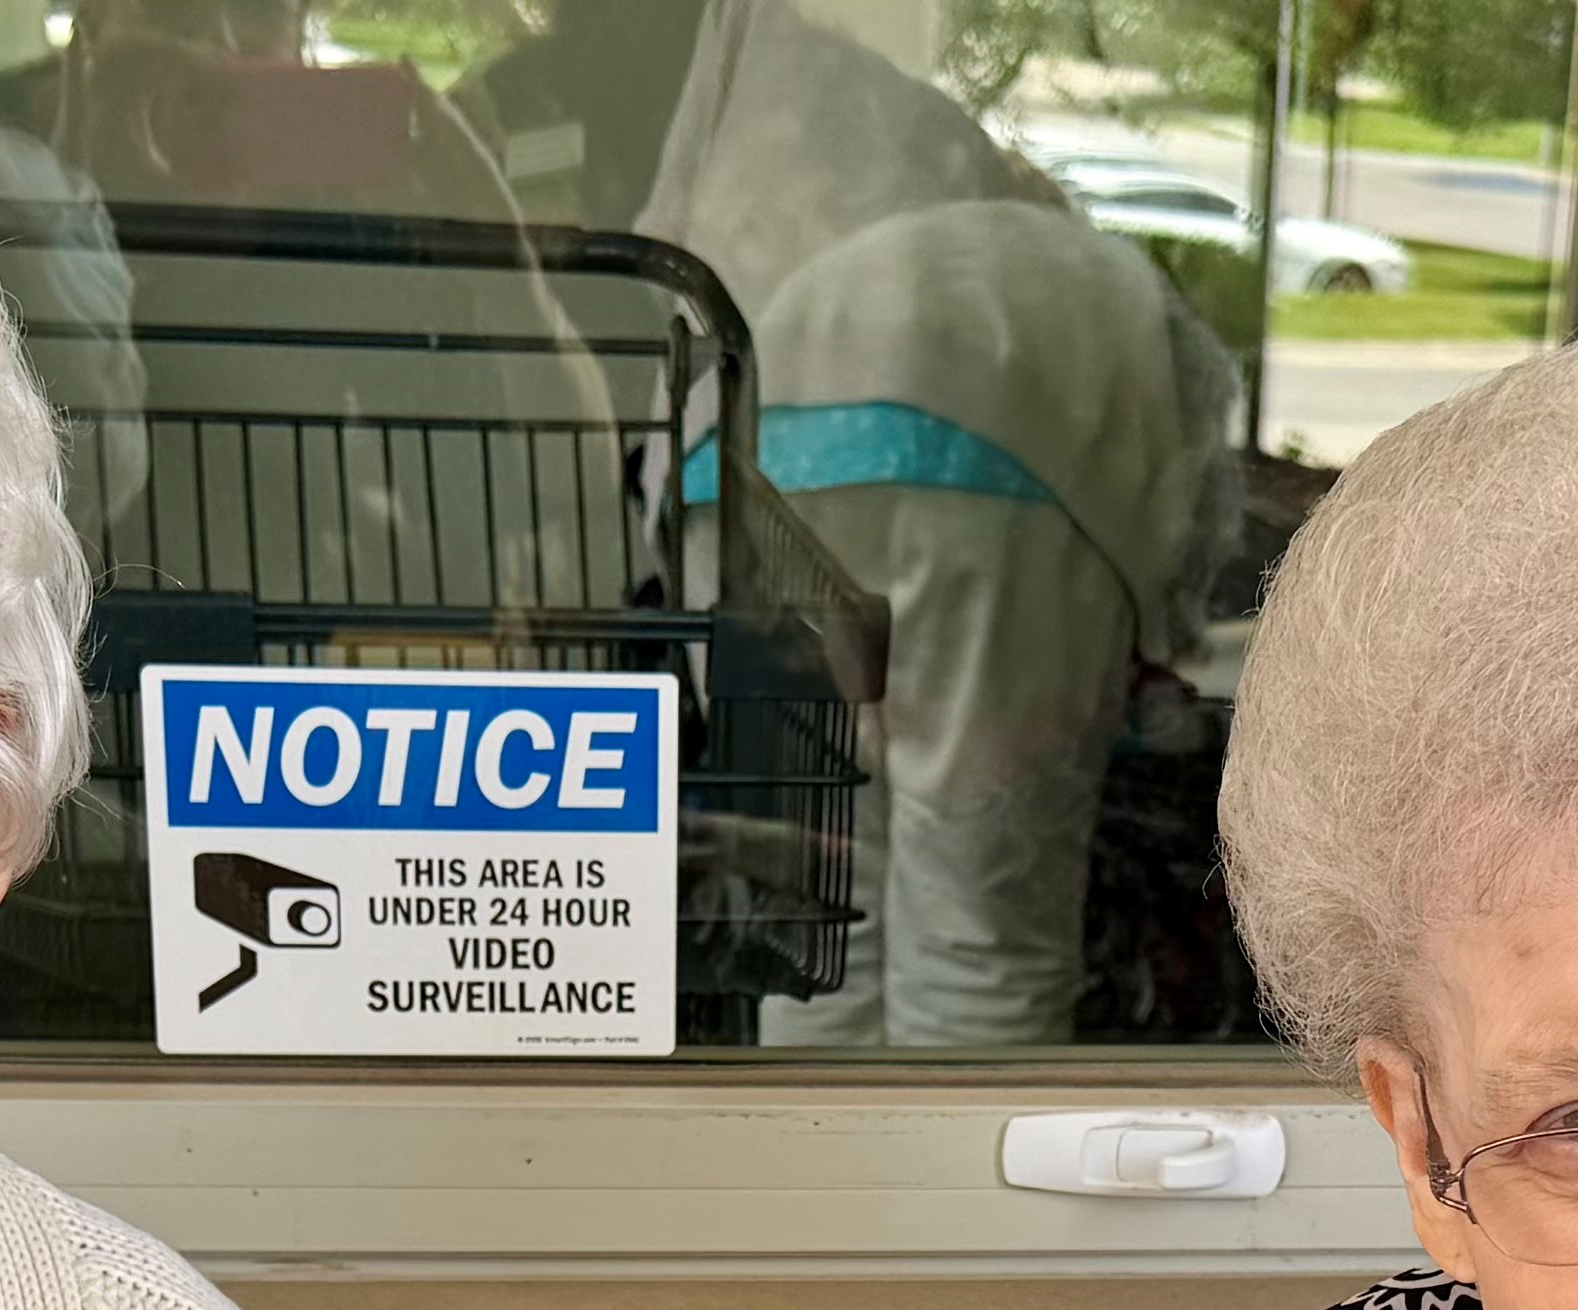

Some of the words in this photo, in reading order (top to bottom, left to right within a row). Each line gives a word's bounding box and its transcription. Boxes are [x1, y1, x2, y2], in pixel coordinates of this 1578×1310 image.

[188, 705, 638, 810] NOTICE
[395, 858, 467, 888] THIS
[478, 859, 563, 888] AREA
[576, 860, 605, 888] IS
[368, 897, 477, 927] UNDER
[489, 898, 529, 926] 24
[542, 898, 631, 927] HOUR
[449, 938, 555, 970] VIDEO
[367, 980, 636, 1014] SURVEILLANCE
